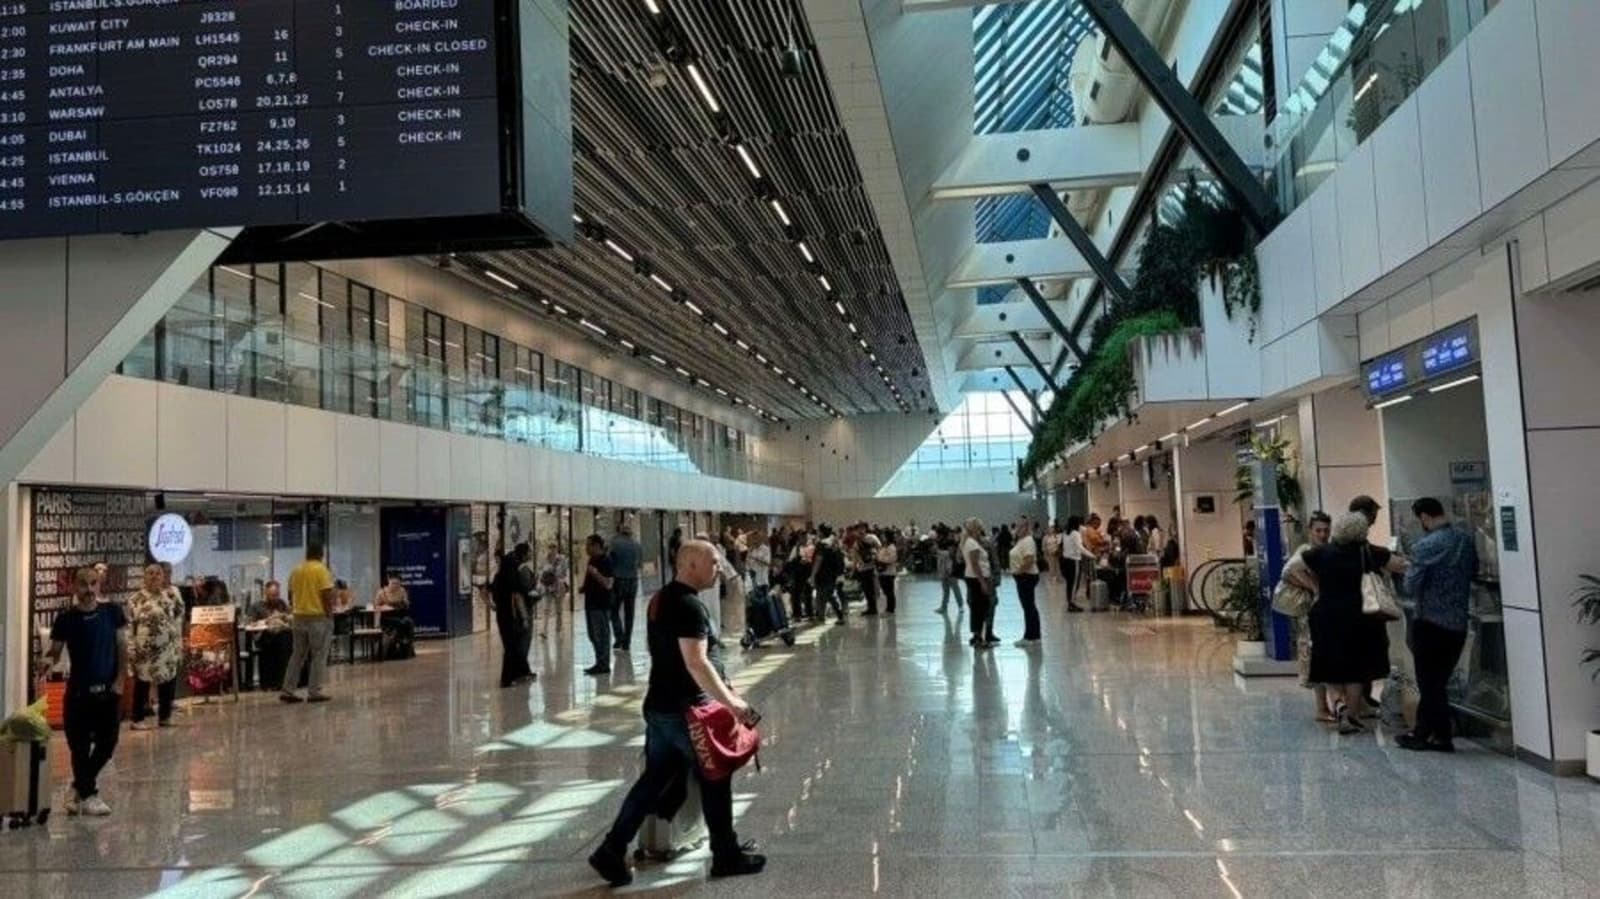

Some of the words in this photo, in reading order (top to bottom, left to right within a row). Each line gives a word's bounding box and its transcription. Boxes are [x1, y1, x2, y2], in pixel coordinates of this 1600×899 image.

[0, 4, 26, 16] 1:15
[50, 21, 96, 33] KUWAIT
[101, 19, 128, 30] CITY
[336, 4, 341, 14] 1
[395, 0, 457, 10] BOARDED
[49, 40, 123, 54] FRANKFURT
[127, 39, 144, 49] AM
[149, 37, 180, 48] MAIN
[196, 32, 240, 45] LH1545
[274, 30, 288, 40] 16
[336, 26, 342, 36] 3
[396, 19, 457, 32] CHECK-IN
[49, 65, 84, 77] DOHA
[275, 51, 288, 62] 11
[336, 47, 343, 58] 5
[368, 43, 431, 56] CHECK-IN
[434, 39, 487, 52] CLOSED
[49, 85, 103, 98] ANTALYA
[337, 70, 343, 80] 1
[397, 63, 459, 76] CHECK-IN
[49, 107, 104, 119] WARSAW
[337, 91, 344, 102] 7
[398, 85, 460, 98] CHECK-IN
[49, 130, 86, 142] DUBAI
[338, 114, 345, 125] 3
[398, 108, 461, 121] CHECK-IN
[49, 150, 108, 164] ISTANBUL
[197, 143, 241, 154] TK1024
[337, 136, 345, 147] 5
[399, 130, 461, 143] CHECK-IN
[49, 173, 95, 185] VIENNA
[338, 158, 346, 169] 2
[339, 181, 346, 191] 1
[37, 493, 72, 514] PARIS
[106, 494, 145, 514] BERLIN
[60, 532, 85, 552] ULM
[87, 531, 145, 551] FLORENCE
